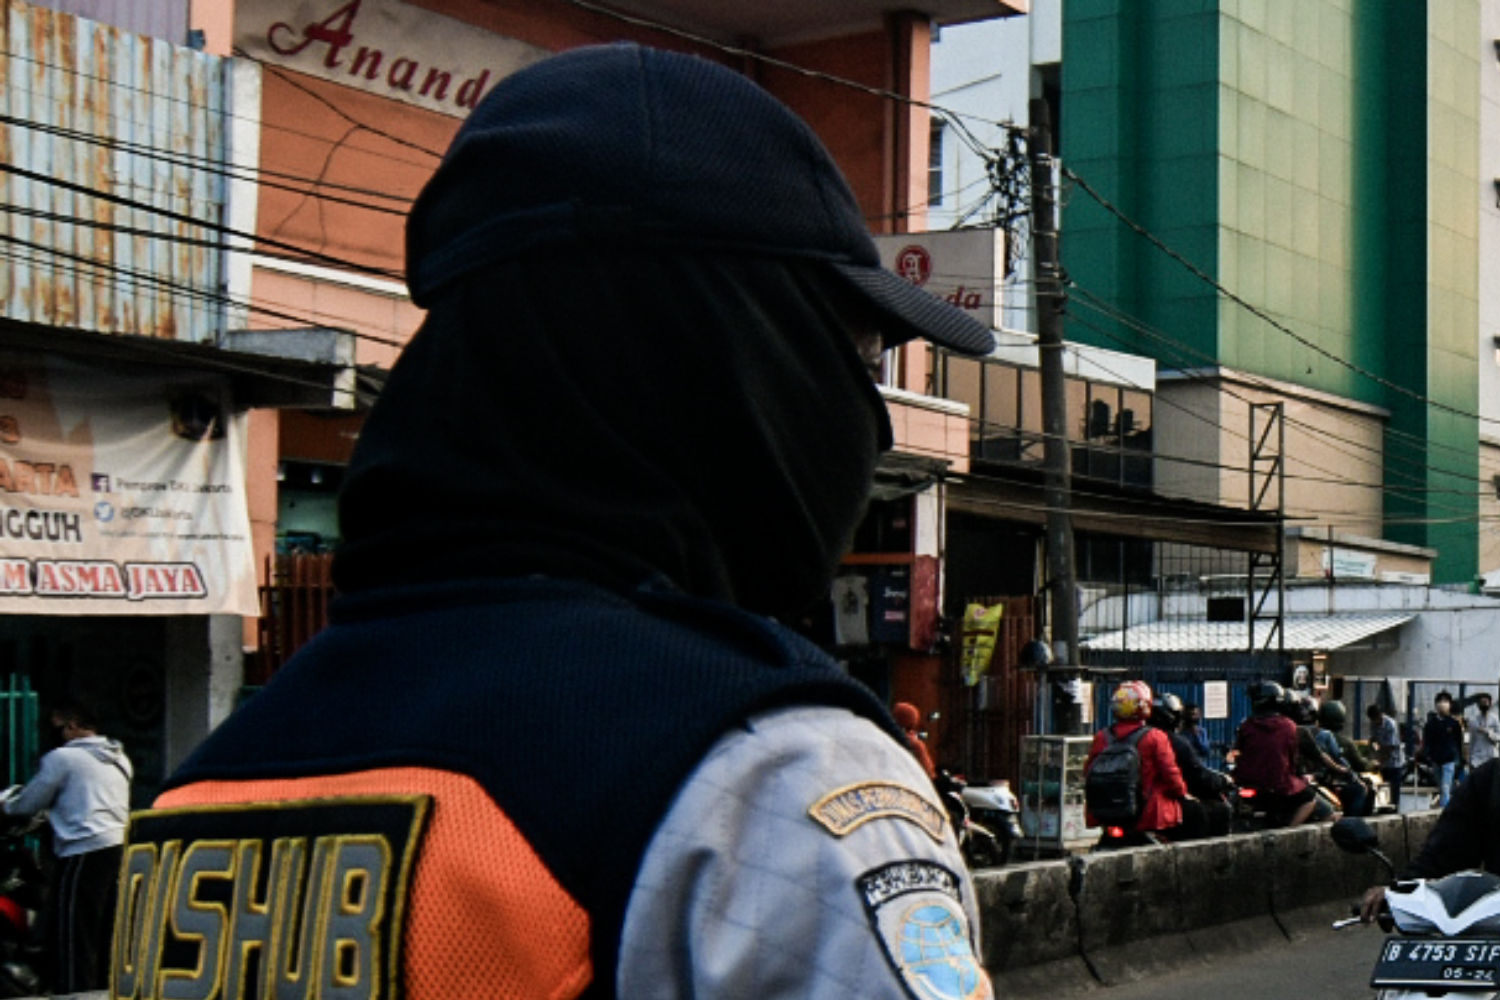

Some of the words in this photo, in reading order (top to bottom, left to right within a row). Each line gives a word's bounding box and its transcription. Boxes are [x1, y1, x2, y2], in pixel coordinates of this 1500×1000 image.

[267, 0, 490, 109] Anand
[40, 564, 125, 595] ASMA
[127, 567, 202, 596] JAYA
[1409, 944, 1458, 962] 4753
